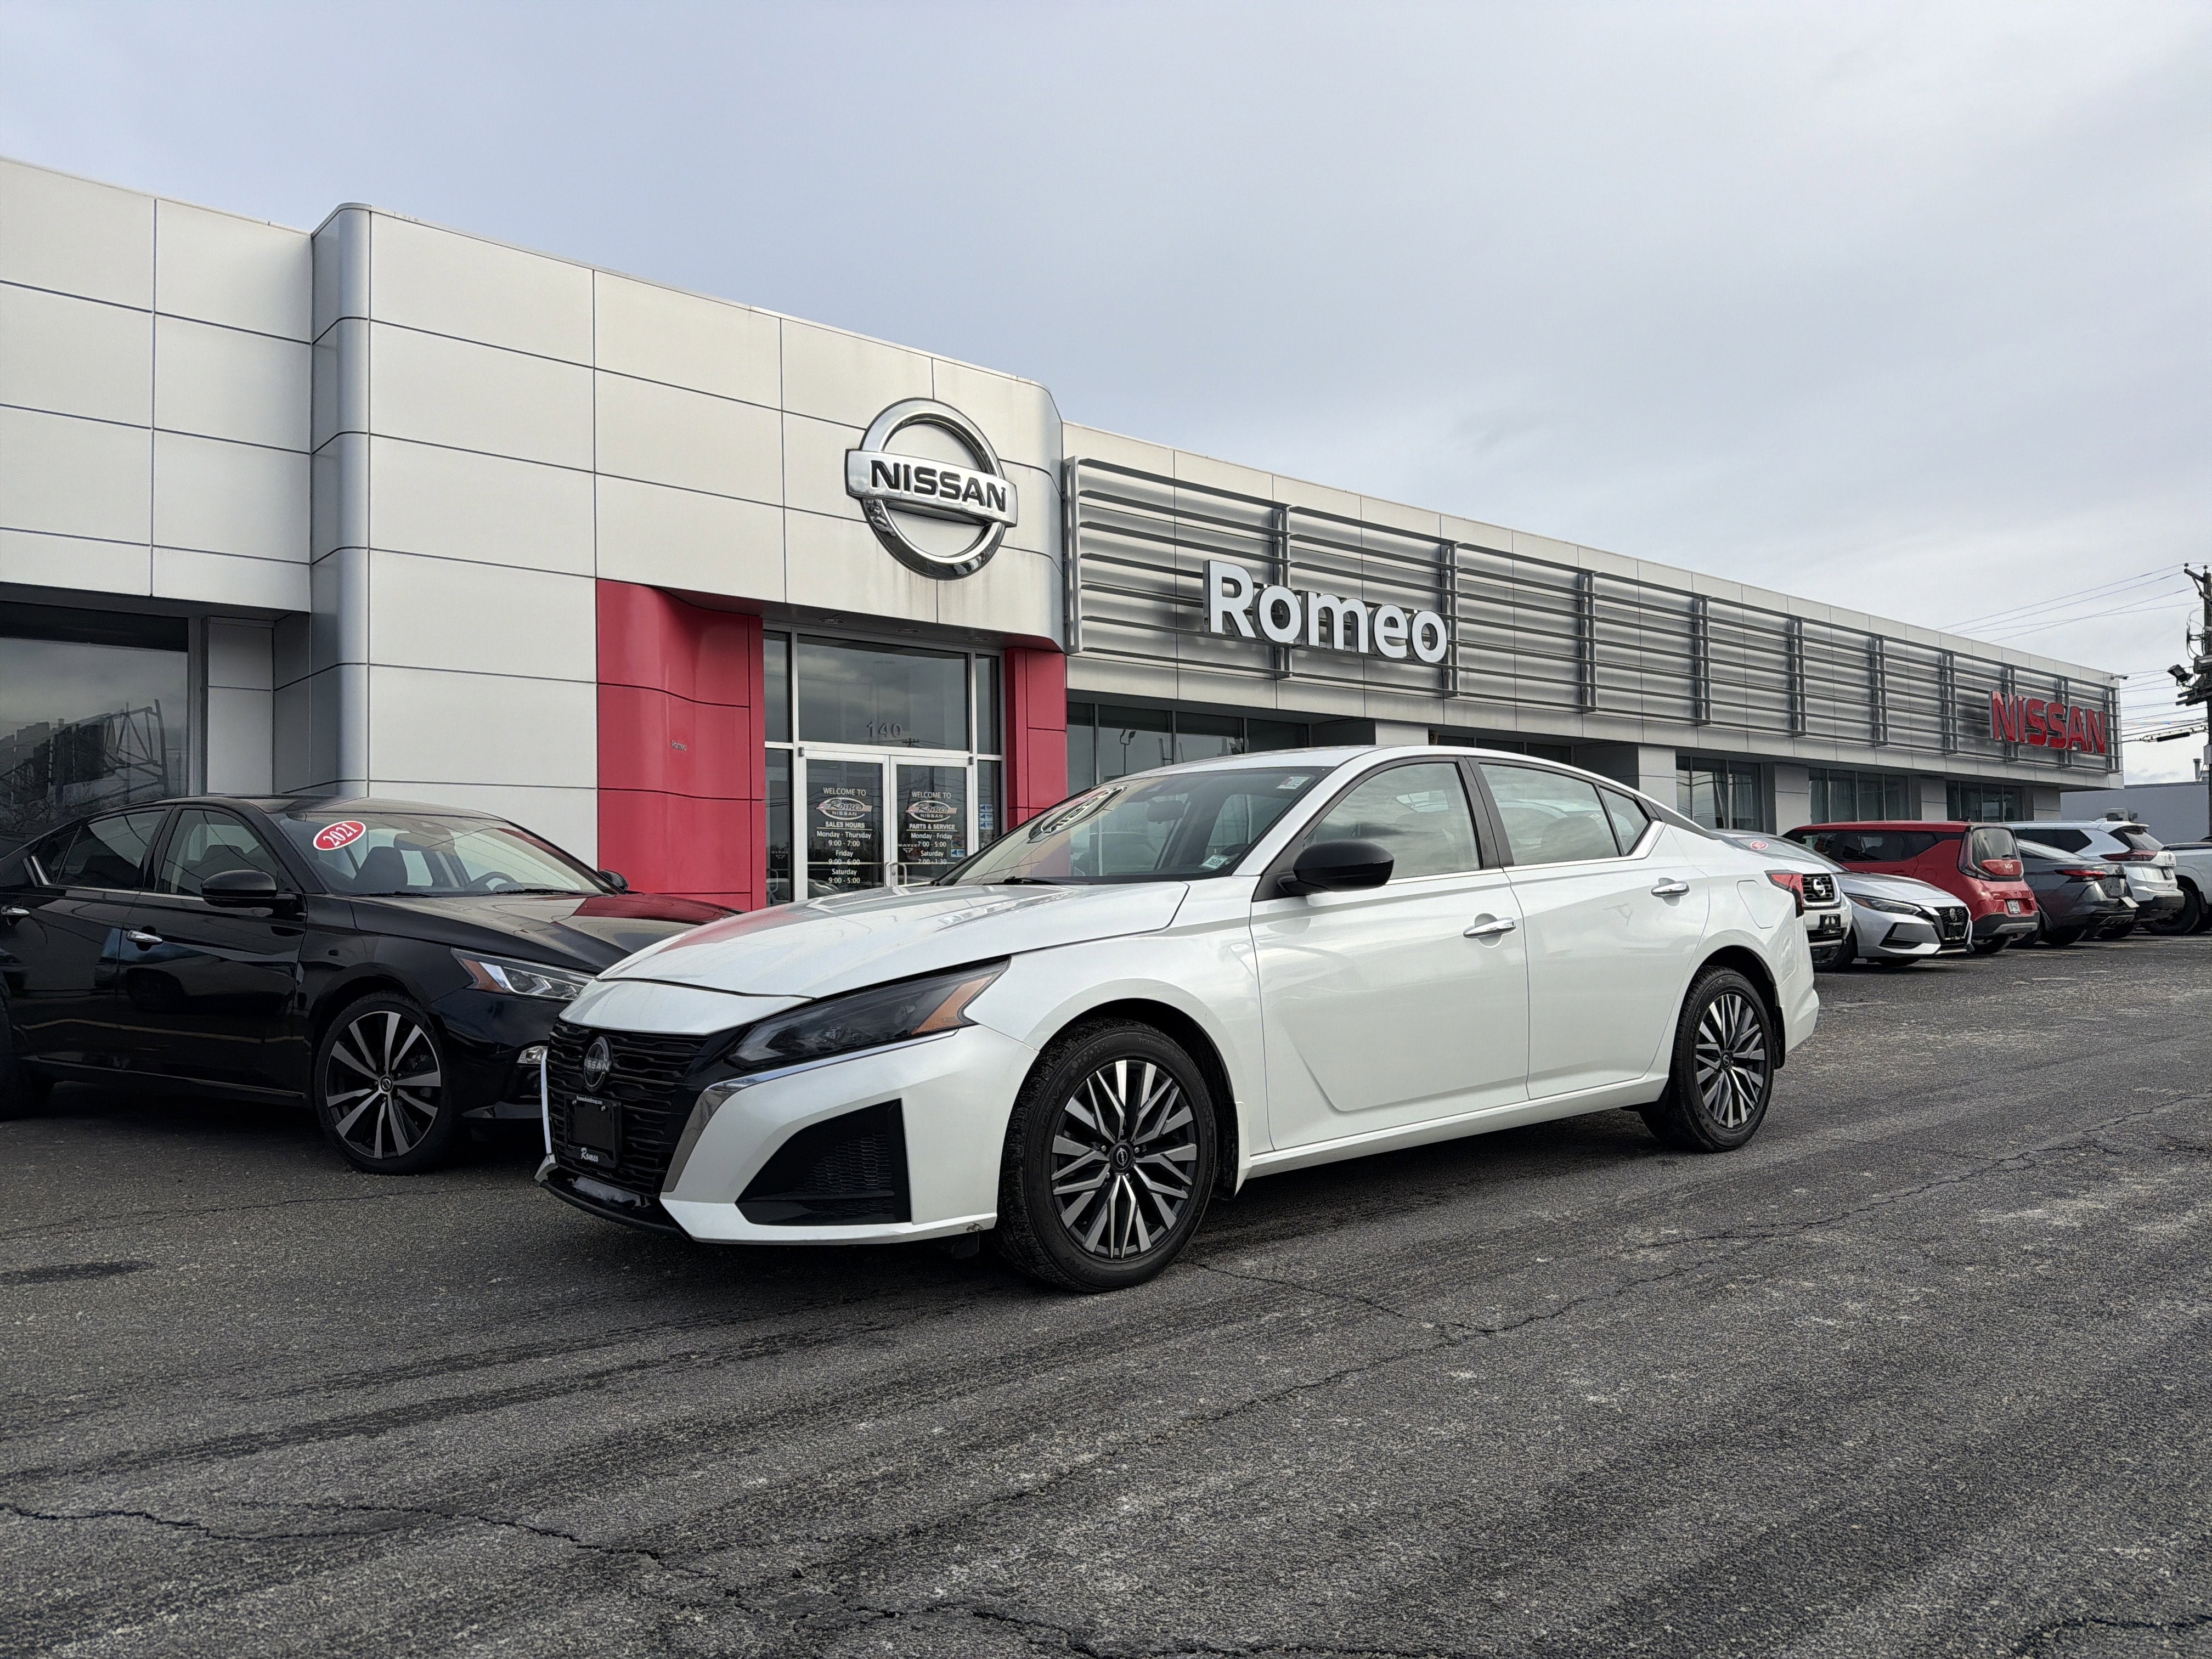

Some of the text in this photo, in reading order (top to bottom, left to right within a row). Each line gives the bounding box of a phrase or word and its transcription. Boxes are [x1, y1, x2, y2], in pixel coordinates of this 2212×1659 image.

[870, 460, 1007, 514] NISSAN
[1203, 559, 1448, 663] Romeo
[1989, 690, 2106, 754] NISSAN
[866, 721, 902, 738] 140
[823, 787, 855, 795] WELCOME
[828, 799, 864, 810] Romeo
[916, 802, 949, 812] Romeo
[323, 823, 359, 847] 2021
[816, 831, 840, 839] Monday
[845, 831, 872, 839] Thursday
[832, 868, 857, 876] Saturday
